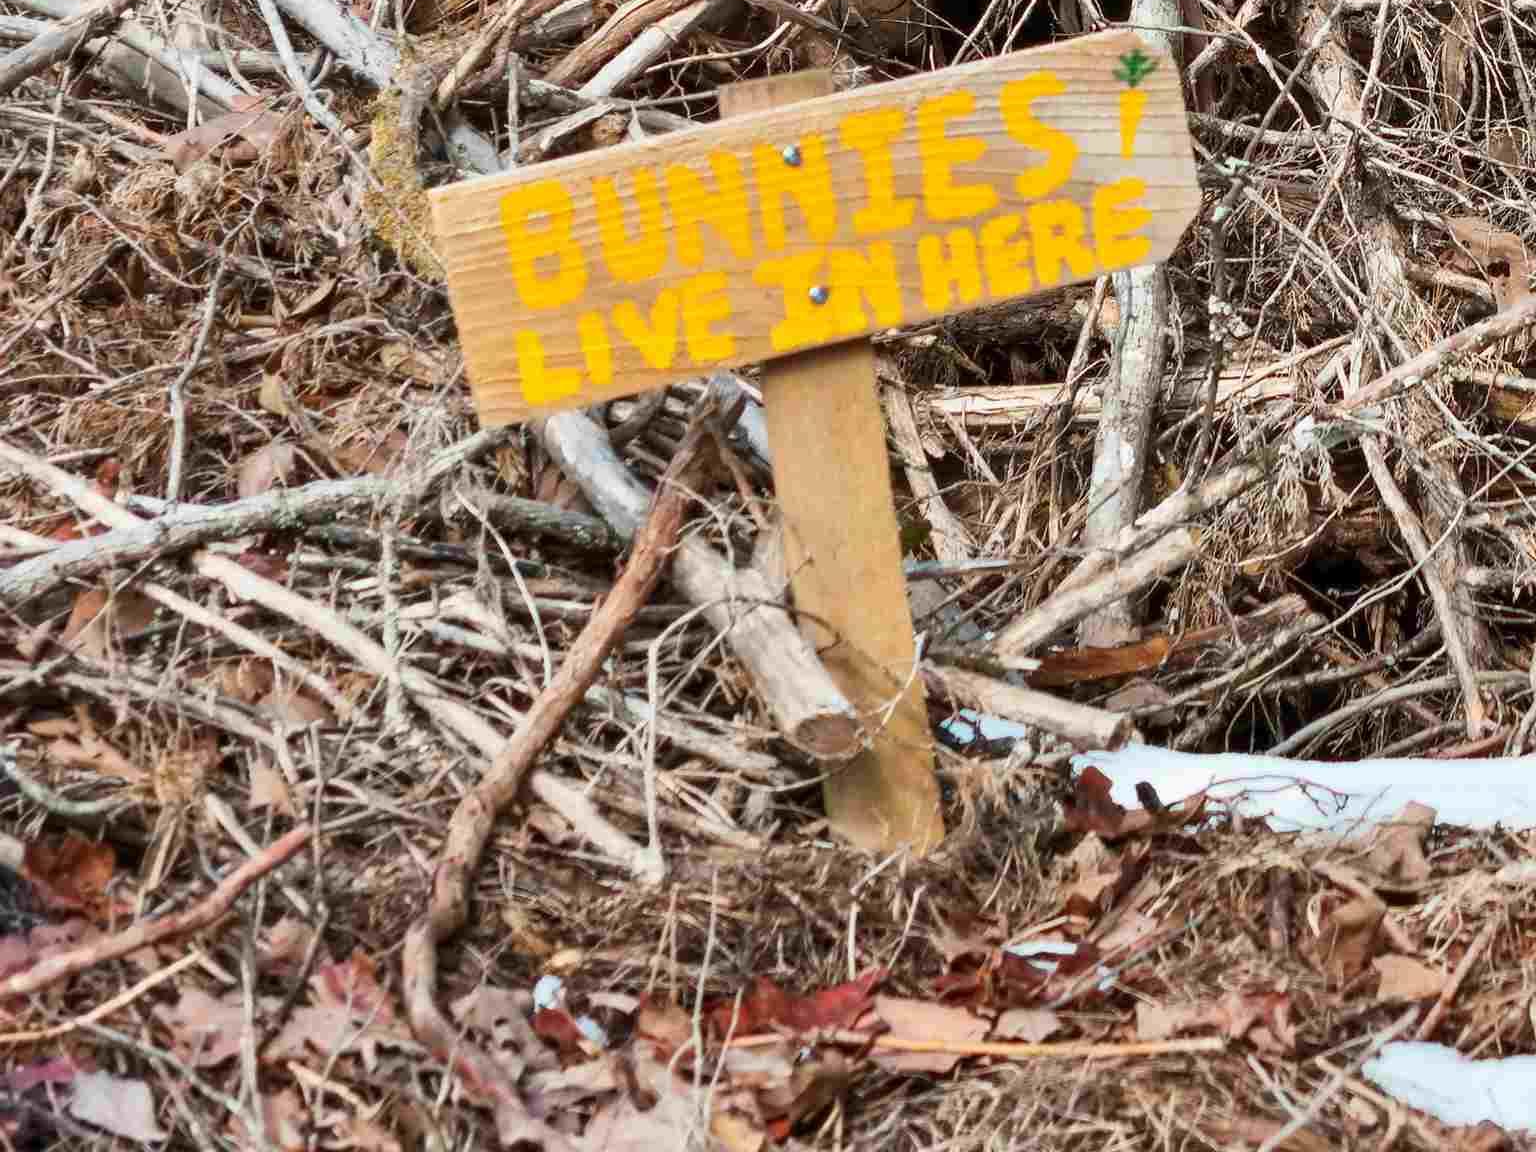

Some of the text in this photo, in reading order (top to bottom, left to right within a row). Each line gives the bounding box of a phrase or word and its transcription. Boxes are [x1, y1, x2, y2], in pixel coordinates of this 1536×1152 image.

[514, 177, 1153, 407] LIVE IN HERE
